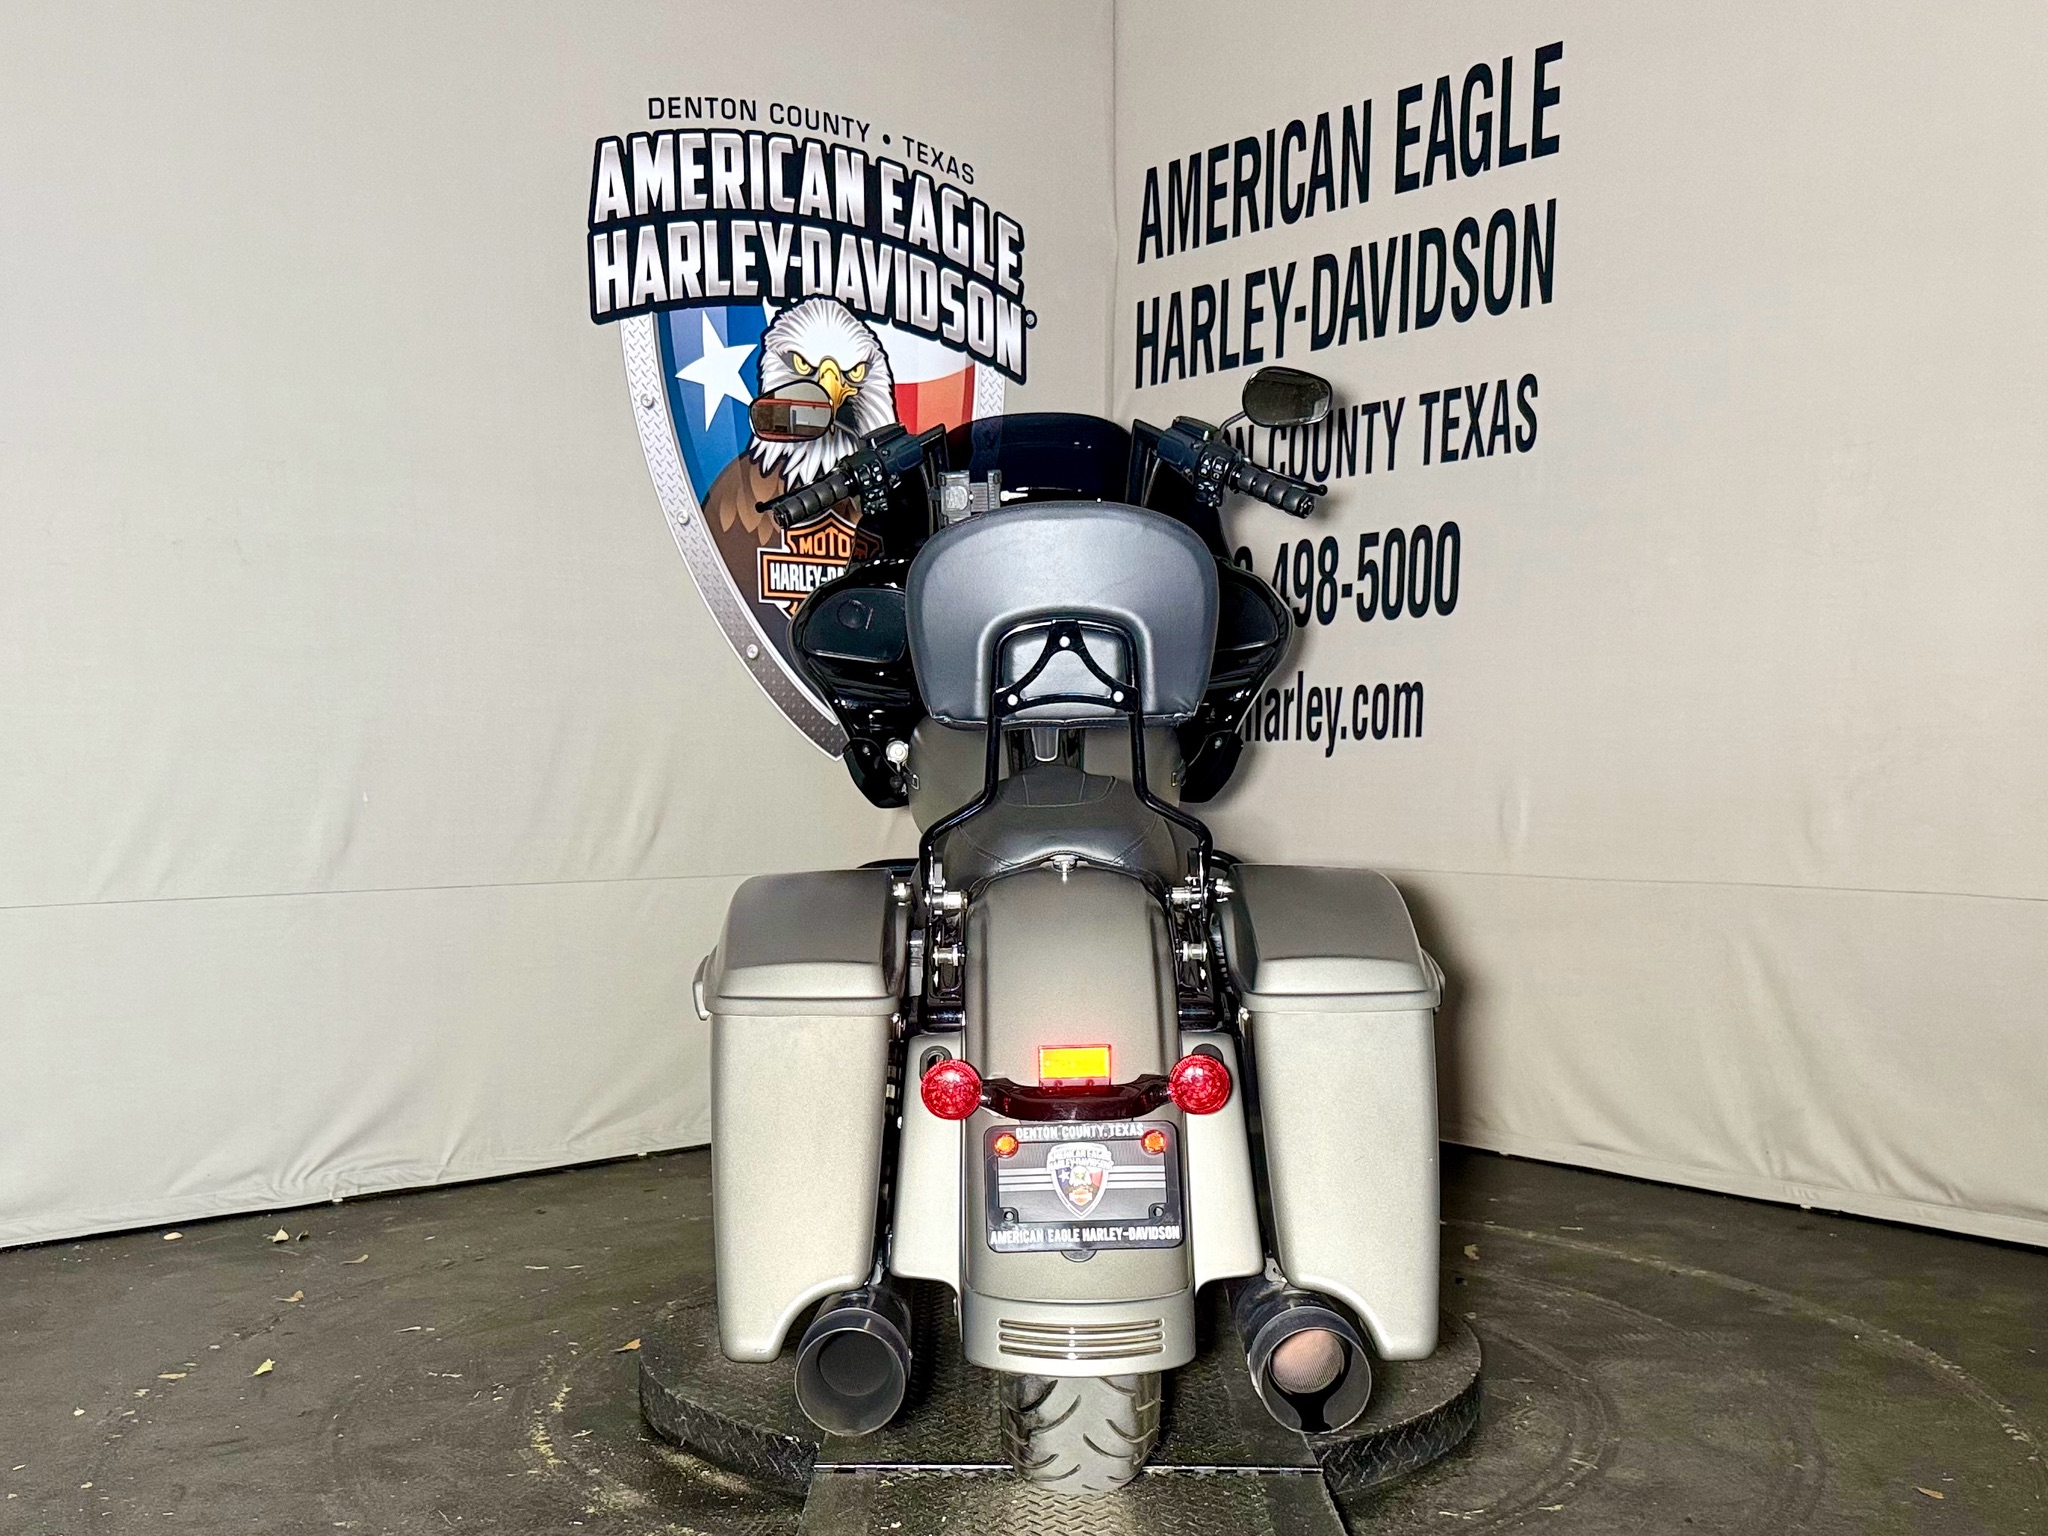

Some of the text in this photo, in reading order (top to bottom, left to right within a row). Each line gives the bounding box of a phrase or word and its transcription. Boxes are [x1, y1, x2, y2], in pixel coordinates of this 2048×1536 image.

[648, 97, 975, 185] DENTON COUNTY TEXAS
[1138, 41, 1563, 264] AMERICAN EAGLE
[593, 131, 1020, 292] AMERICAN EAGLE
[593, 219, 1023, 377] HARLEY-DAVIDSON
[1135, 198, 1557, 389] HARLEY-DAVIDSON
[1418, 373, 1538, 466] TEXAS
[1015, 1126, 1059, 1141] DENTON
[1109, 1122, 1144, 1138] TEXAS
[990, 1225, 1181, 1245] AMERICAN EAGLE HARLEY-DAVIDSON
